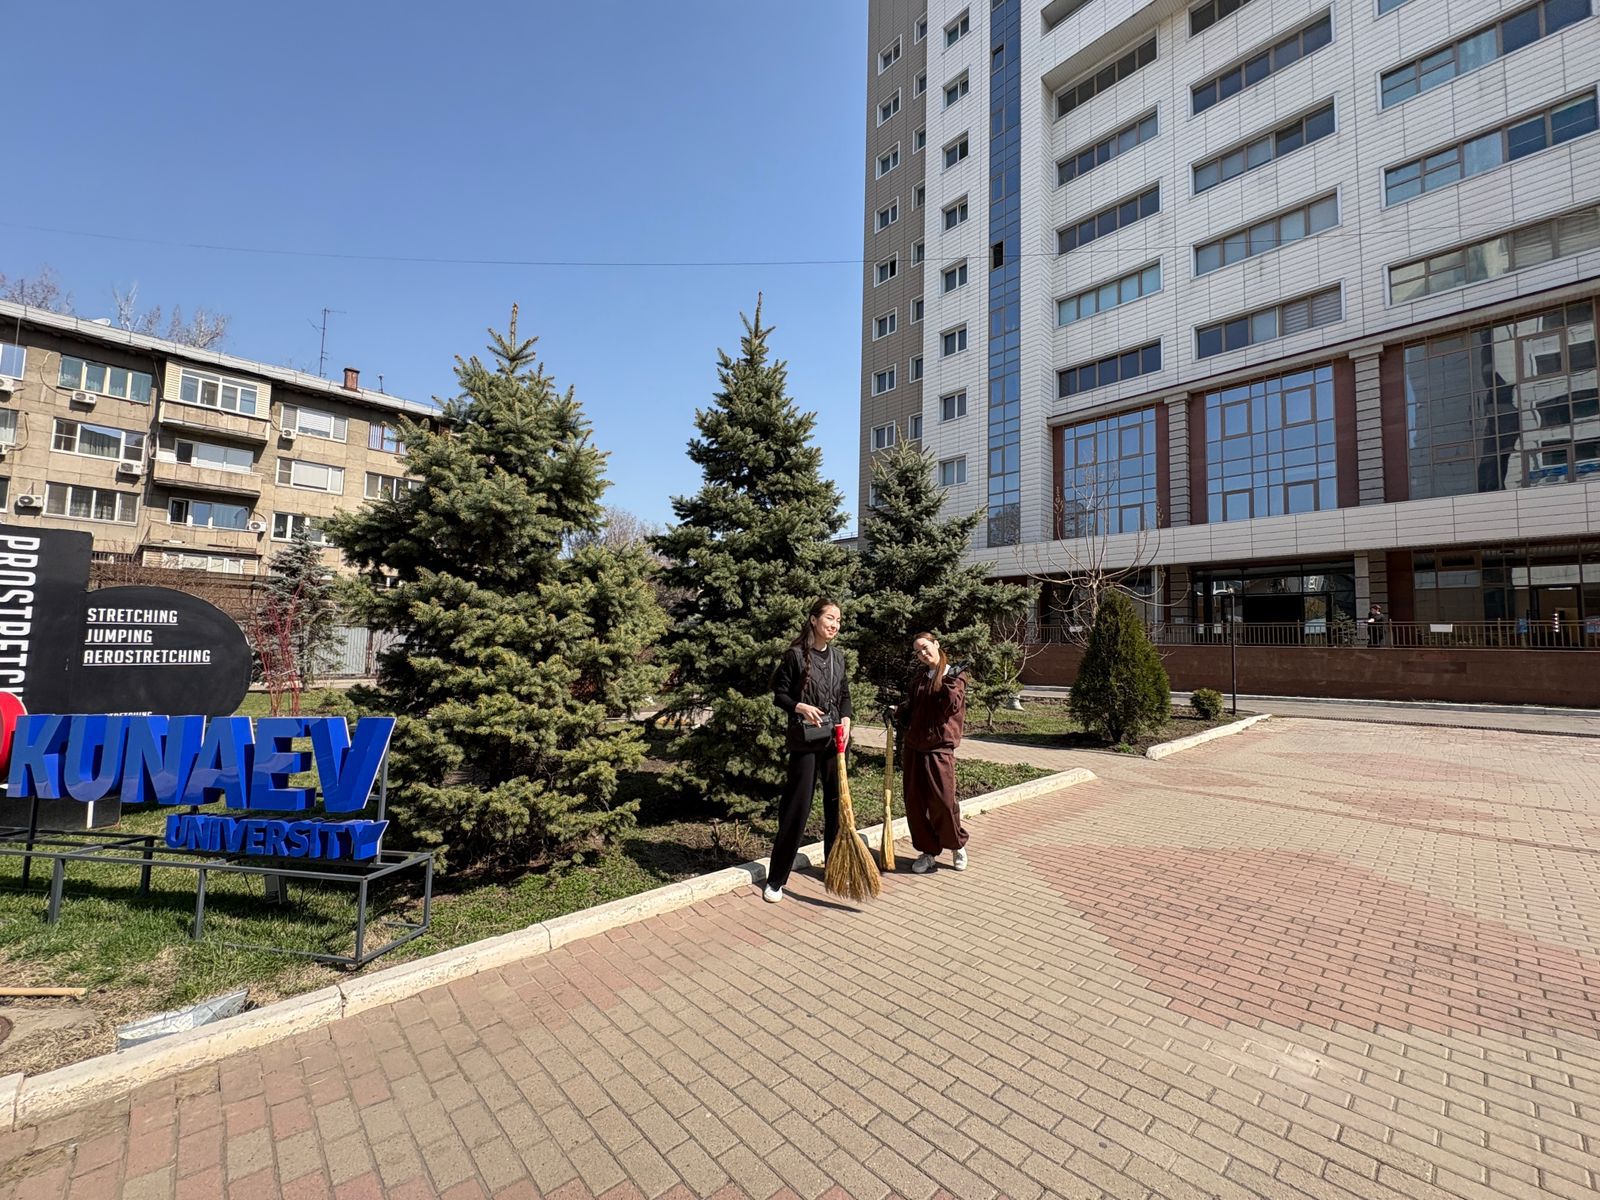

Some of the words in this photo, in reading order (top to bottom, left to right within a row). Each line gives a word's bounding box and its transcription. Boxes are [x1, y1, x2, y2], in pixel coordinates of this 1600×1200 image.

[87, 607, 179, 624] STRETCHING
[84, 628, 154, 644] JUMPING
[82, 649, 212, 665] AEROSTRETCHING
[6, 713, 398, 812] KUNAEV
[165, 813, 390, 861] UNIVERSITY
